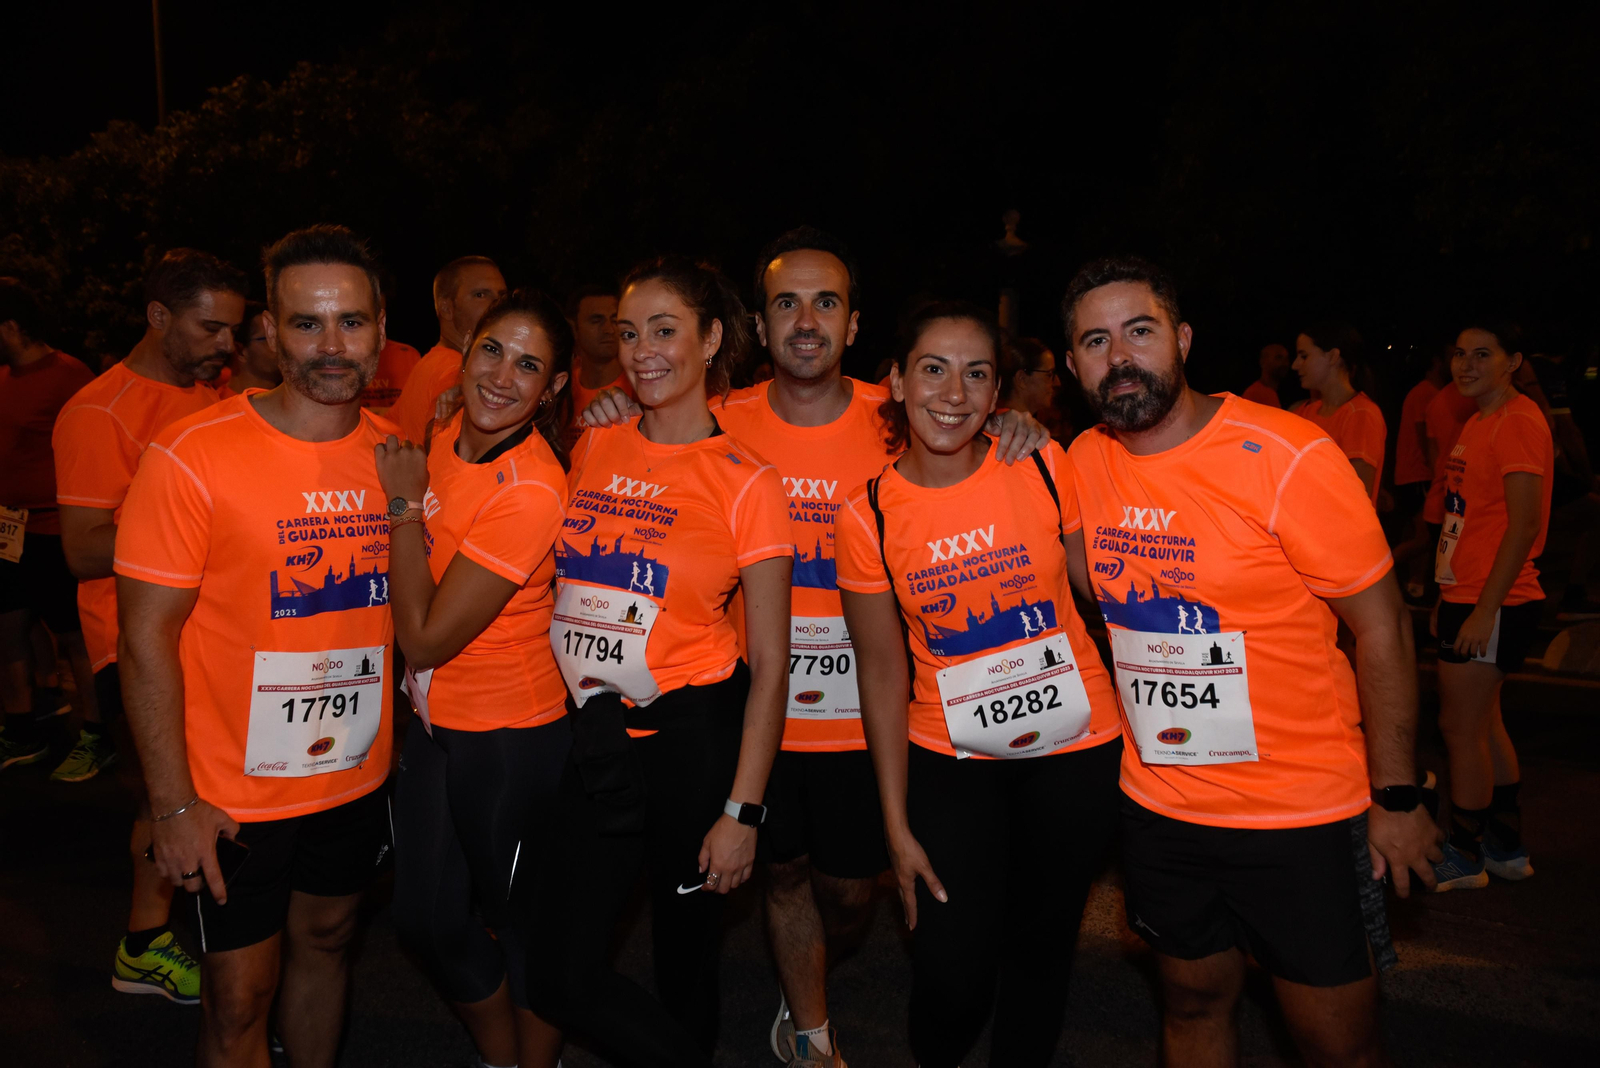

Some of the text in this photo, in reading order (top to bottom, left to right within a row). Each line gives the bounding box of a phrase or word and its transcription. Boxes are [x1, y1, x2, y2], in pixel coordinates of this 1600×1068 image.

[603, 473, 669, 499] XXXV
[301, 489, 366, 514] XXXV
[575, 499, 675, 527] GUADALQUIVIR
[576, 489, 678, 516] CARRERA NOCTURNA
[276, 516, 330, 529] CARRERA
[1118, 505, 1177, 531] XXXV
[288, 525, 390, 543] GUADALQUIVIR
[926, 524, 995, 564] XXXV
[1096, 526, 1196, 547] CARRERA NOCTURNA
[906, 543, 1027, 582] CARRERA NOCTURNA
[1099, 538, 1195, 563] GUADALQUIVIR
[917, 554, 1032, 593] GUADALQUIVIR
[274, 608, 297, 618] 2023
[563, 629, 624, 665] 17794
[963, 692, 984, 702] CARRERA
[984, 685, 1010, 696] NOCTURNA
[1018, 673, 1051, 686] GUADALQUIVIR
[1060, 666, 1071, 674] 2023
[1130, 678, 1220, 709] 17654
[282, 691, 359, 723] 17791
[973, 684, 1062, 729] 18282
